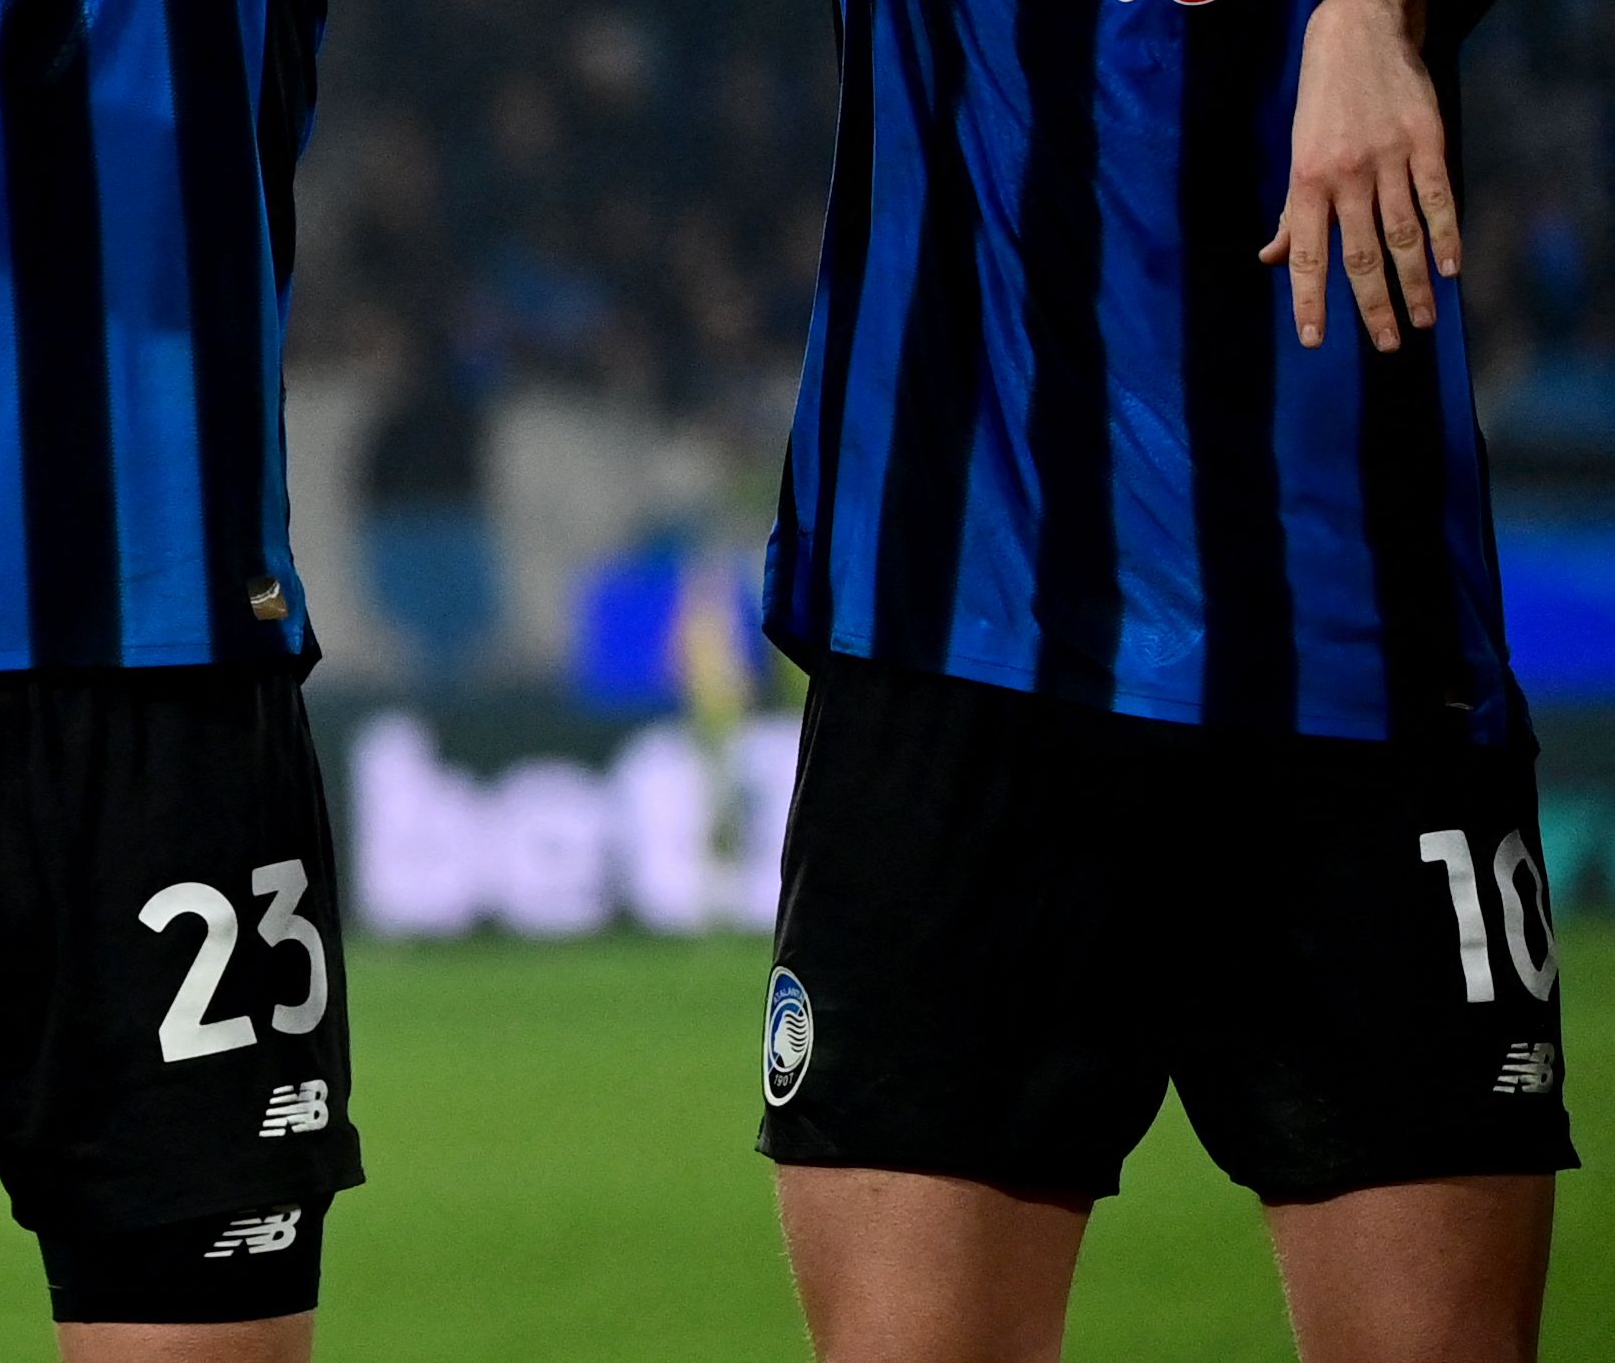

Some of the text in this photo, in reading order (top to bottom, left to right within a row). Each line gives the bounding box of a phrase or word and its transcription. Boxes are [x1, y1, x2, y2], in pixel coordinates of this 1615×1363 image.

[138, 858, 328, 1063] 23
[1419, 828, 1558, 1003] 10
[773, 1072, 795, 1088] 1907
